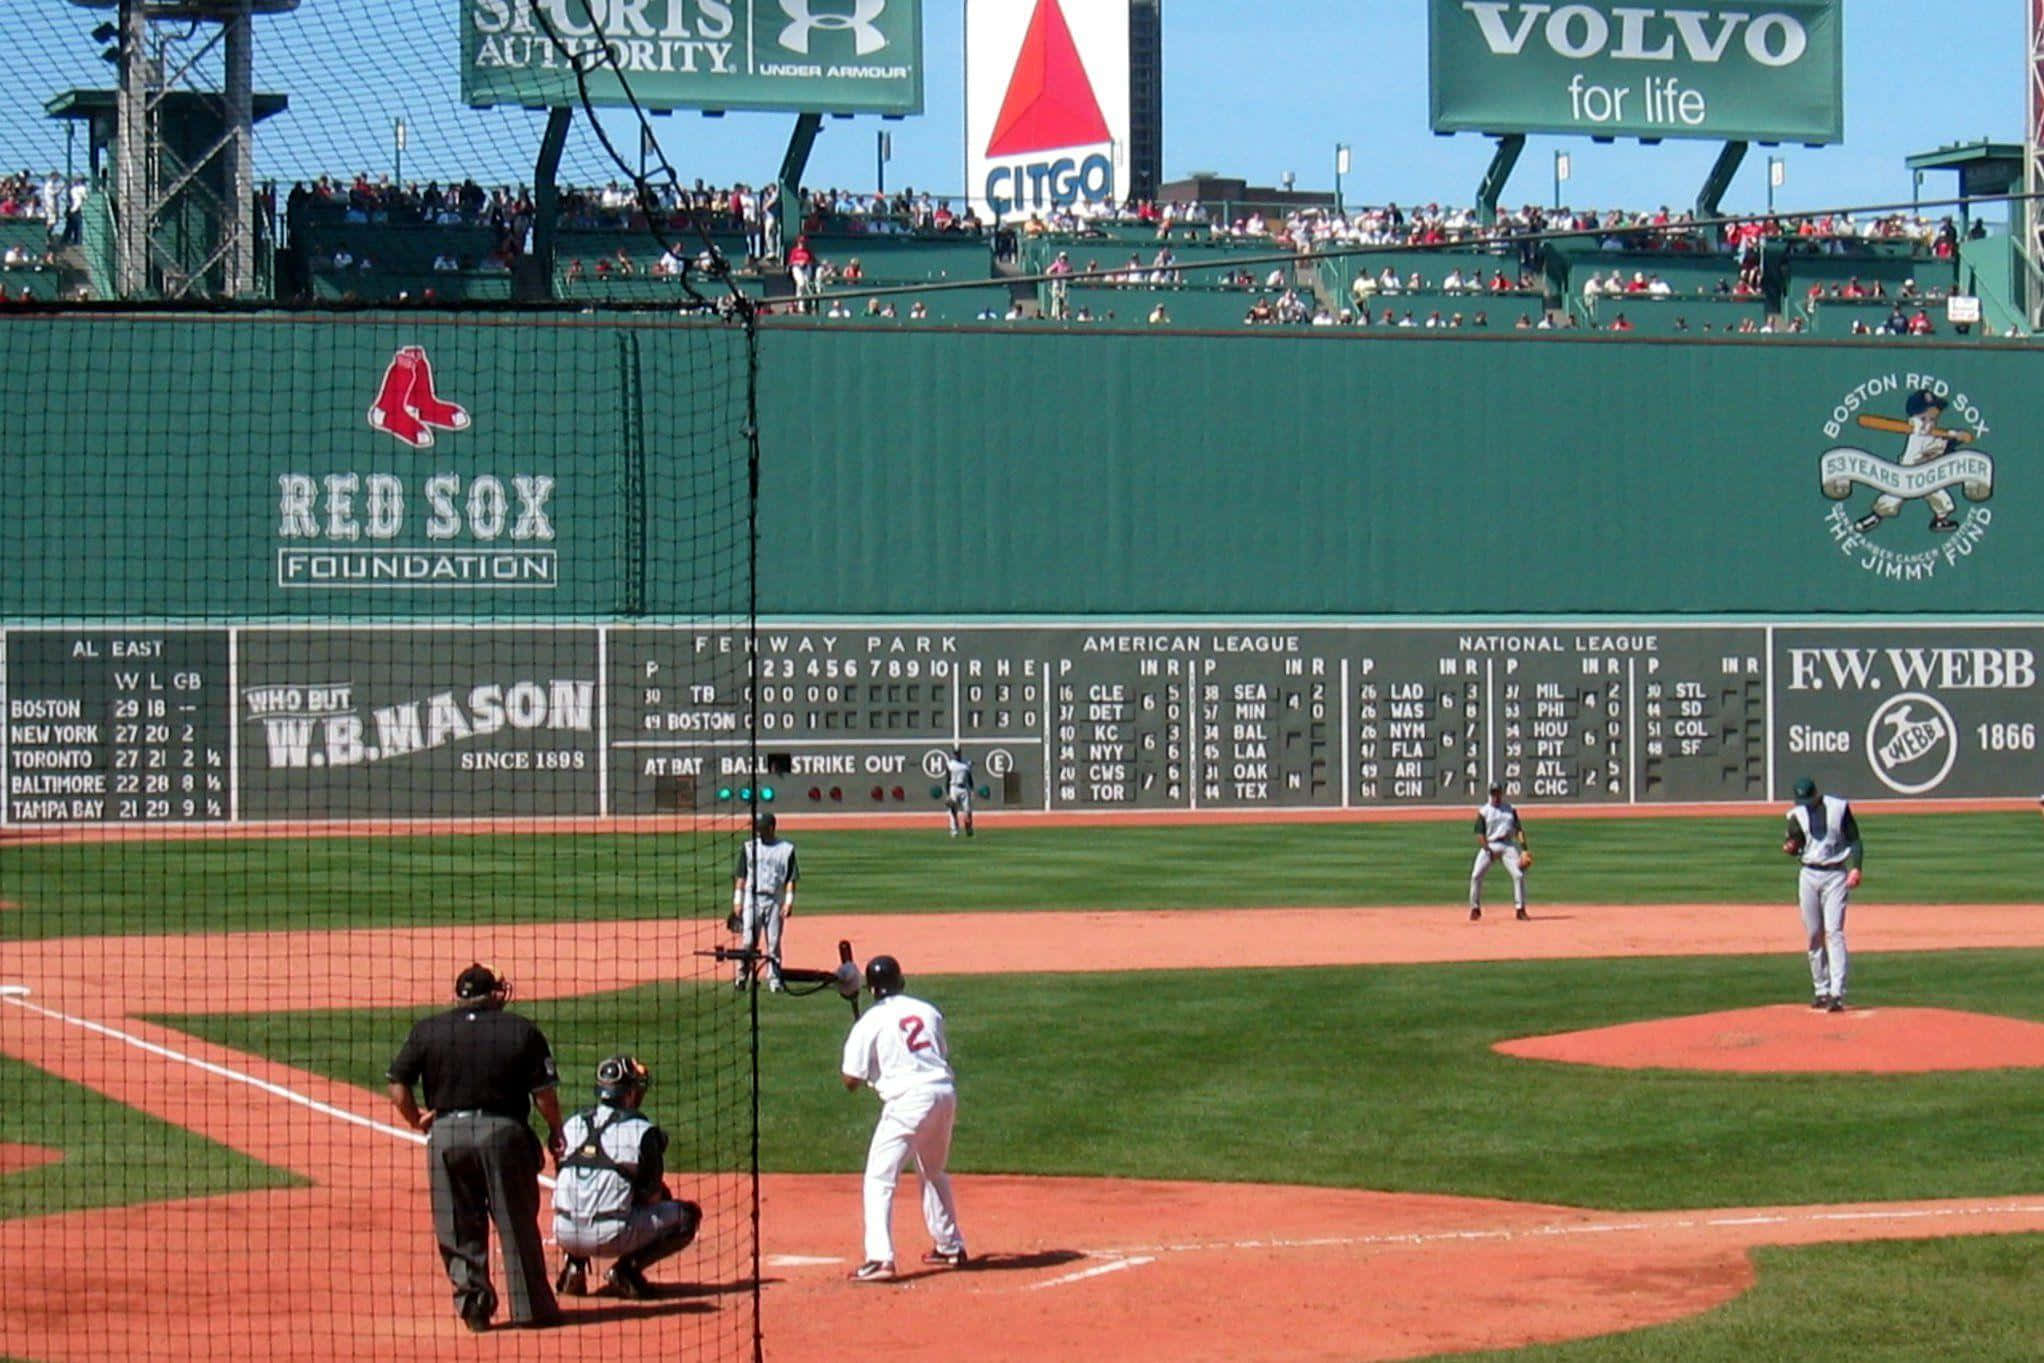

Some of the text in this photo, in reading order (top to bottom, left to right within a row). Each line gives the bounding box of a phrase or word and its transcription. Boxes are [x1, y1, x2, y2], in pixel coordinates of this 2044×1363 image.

[1462, 2, 1807, 67] VOLVO
[475, 37, 737, 75] AUTHORITY
[759, 63, 908, 80] UNDER ARMOUR
[1568, 75, 1706, 125] for life
[986, 153, 1111, 215] CITGO
[1823, 373, 1991, 440] BOSTON RED SOX
[1827, 455, 1989, 489] 53 YEARS TOGETHER
[279, 472, 556, 541] RED SOX
[1824, 502, 1860, 556] THE
[1861, 555, 1936, 580] JIMMY
[1944, 507, 1992, 567] FUND
[287, 555, 549, 579] FOUNDATION
[73, 641, 164, 656] AL EAST
[868, 637, 955, 652] PARK
[1084, 636, 1659, 651] AMERICAN LEAGUE NATIONAL LEAGUE
[647, 659, 1033, 677] P 2 3 4 5 6 7 8 9 10 R H E
[1061, 658, 1323, 675] P IN R P IN R
[1363, 658, 1760, 674] P IN R P IN R P IN R
[1886, 647, 2037, 690] WEBB
[115, 673, 200, 690] W L GB
[691, 686, 1035, 702] TB 0 0 0 0 0 3 0
[1090, 685, 1123, 701] CLE
[1235, 685, 1322, 699] SEA 2
[1392, 684, 1423, 699] LAD
[1537, 684, 1563, 698] MIL
[1676, 683, 1705, 697] STL
[247, 688, 351, 714] WHO BUT
[1144, 696, 1154, 710] 6
[1290, 695, 1298, 709] 4
[1682, 701, 1701, 716] SD
[12, 700, 165, 718] BOSTON 29 18
[1090, 704, 1179, 720] DET 0
[1237, 704, 1323, 719] MIN 0
[1392, 703, 1423, 718] WAS
[1538, 702, 1563, 716] PHI
[668, 713, 735, 730] BOSTON
[764, 714, 774, 728] 0
[783, 714, 793, 728] 0
[811, 714, 815, 728] 1
[971, 713, 978, 728] 1
[999, 712, 1008, 727] 3
[1025, 712, 1035, 726] 0
[1675, 721, 1707, 736] COL
[12, 725, 193, 742] NEW YORK 27 20 2
[1095, 725, 1117, 740] KC
[1234, 725, 1266, 739] BAL
[1391, 723, 1425, 738] NYM
[1534, 722, 1567, 737] HOU
[1145, 735, 1154, 749] 6
[1788, 723, 2036, 753] Since 1866
[1889, 724, 1936, 762] WEBB
[1091, 745, 1178, 760] NYY 6
[1235, 744, 1265, 758] LAA
[1392, 742, 1422, 757] FLA
[1538, 741, 1563, 755] PIT
[1682, 740, 1701, 754] SF
[13, 750, 193, 767] TORONTO 27 21 2
[462, 752, 584, 768] SINCE 1898
[645, 758, 666, 775] AT
[672, 758, 702, 774] BAT
[792, 756, 854, 773] STRIKE
[866, 756, 905, 772] OUT
[1090, 765, 1179, 780] CWS 6
[1234, 764, 1299, 788] OAK N
[1396, 762, 1420, 777] ARI
[1537, 761, 1565, 776] ATL
[12, 775, 193, 793] BALTIMORE 22 28 8
[1236, 783, 1266, 798] TEX
[1395, 781, 1421, 796] CIN
[1535, 780, 1567, 794] CHC
[1091, 785, 1123, 800] TOR
[13, 799, 194, 820] TAMPA BAY 21 29 9
[899, 1015, 931, 1054] 2
